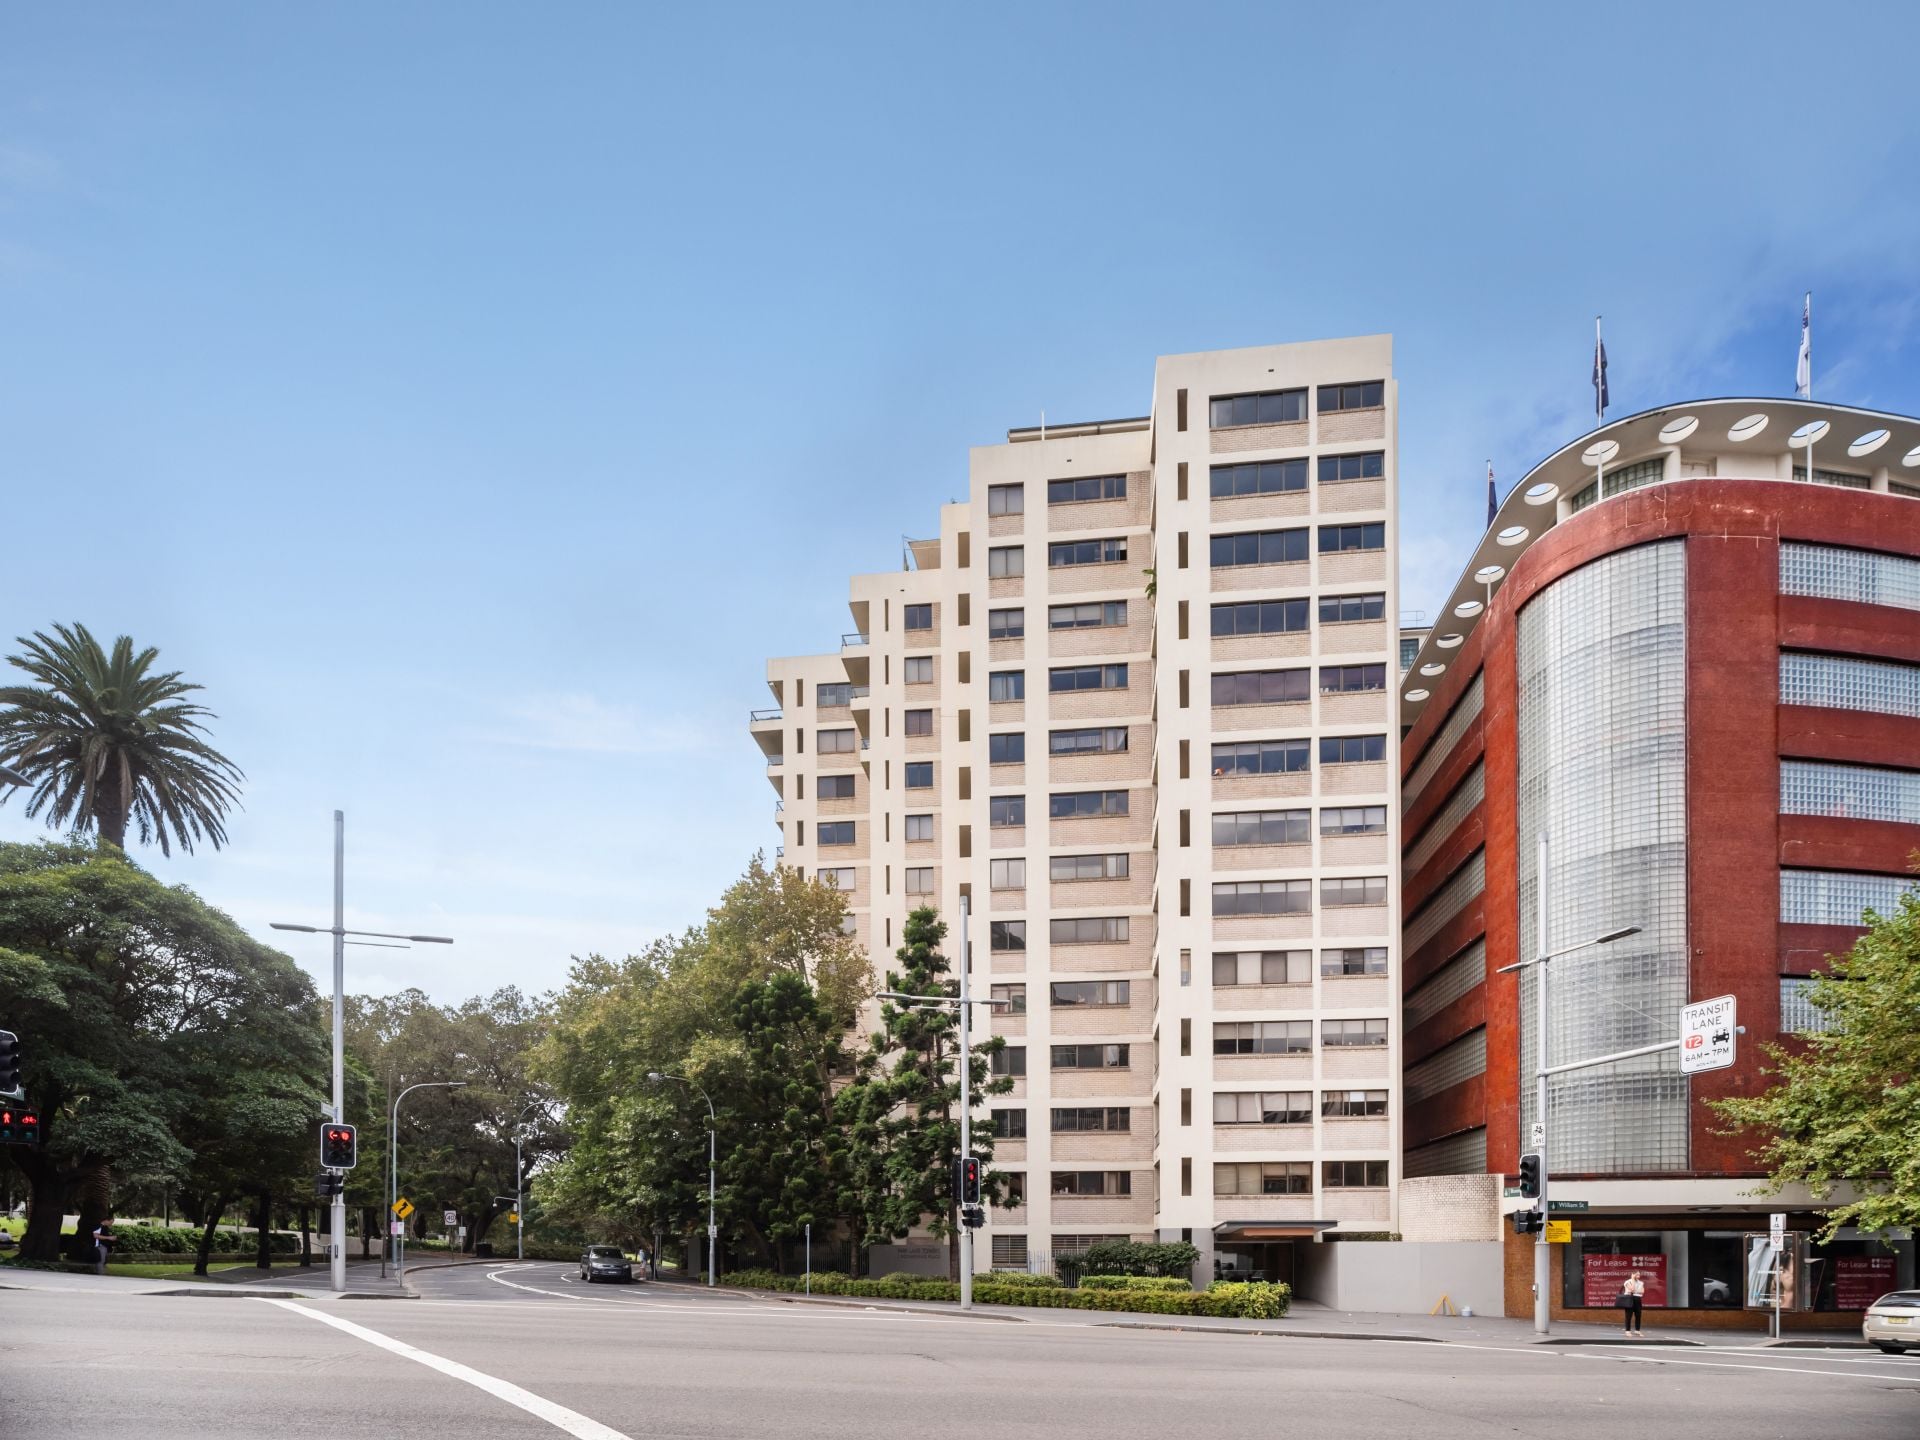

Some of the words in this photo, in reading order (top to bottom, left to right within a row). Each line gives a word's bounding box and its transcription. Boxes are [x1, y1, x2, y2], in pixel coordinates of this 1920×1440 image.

[1685, 1001, 1731, 1021] TRANSIT
[1692, 1015, 1722, 1031] LANE
[1688, 1036, 1702, 1048] T2
[1685, 1052, 1703, 1062] 6AM
[1712, 1047, 1730, 1057] 7PM
[1558, 1201, 1578, 1209] William
[1588, 1259, 1601, 1267] For
[1604, 1259, 1628, 1267] Lease
[1838, 1260, 1849, 1268] For
[1850, 1260, 1868, 1268] Lease
